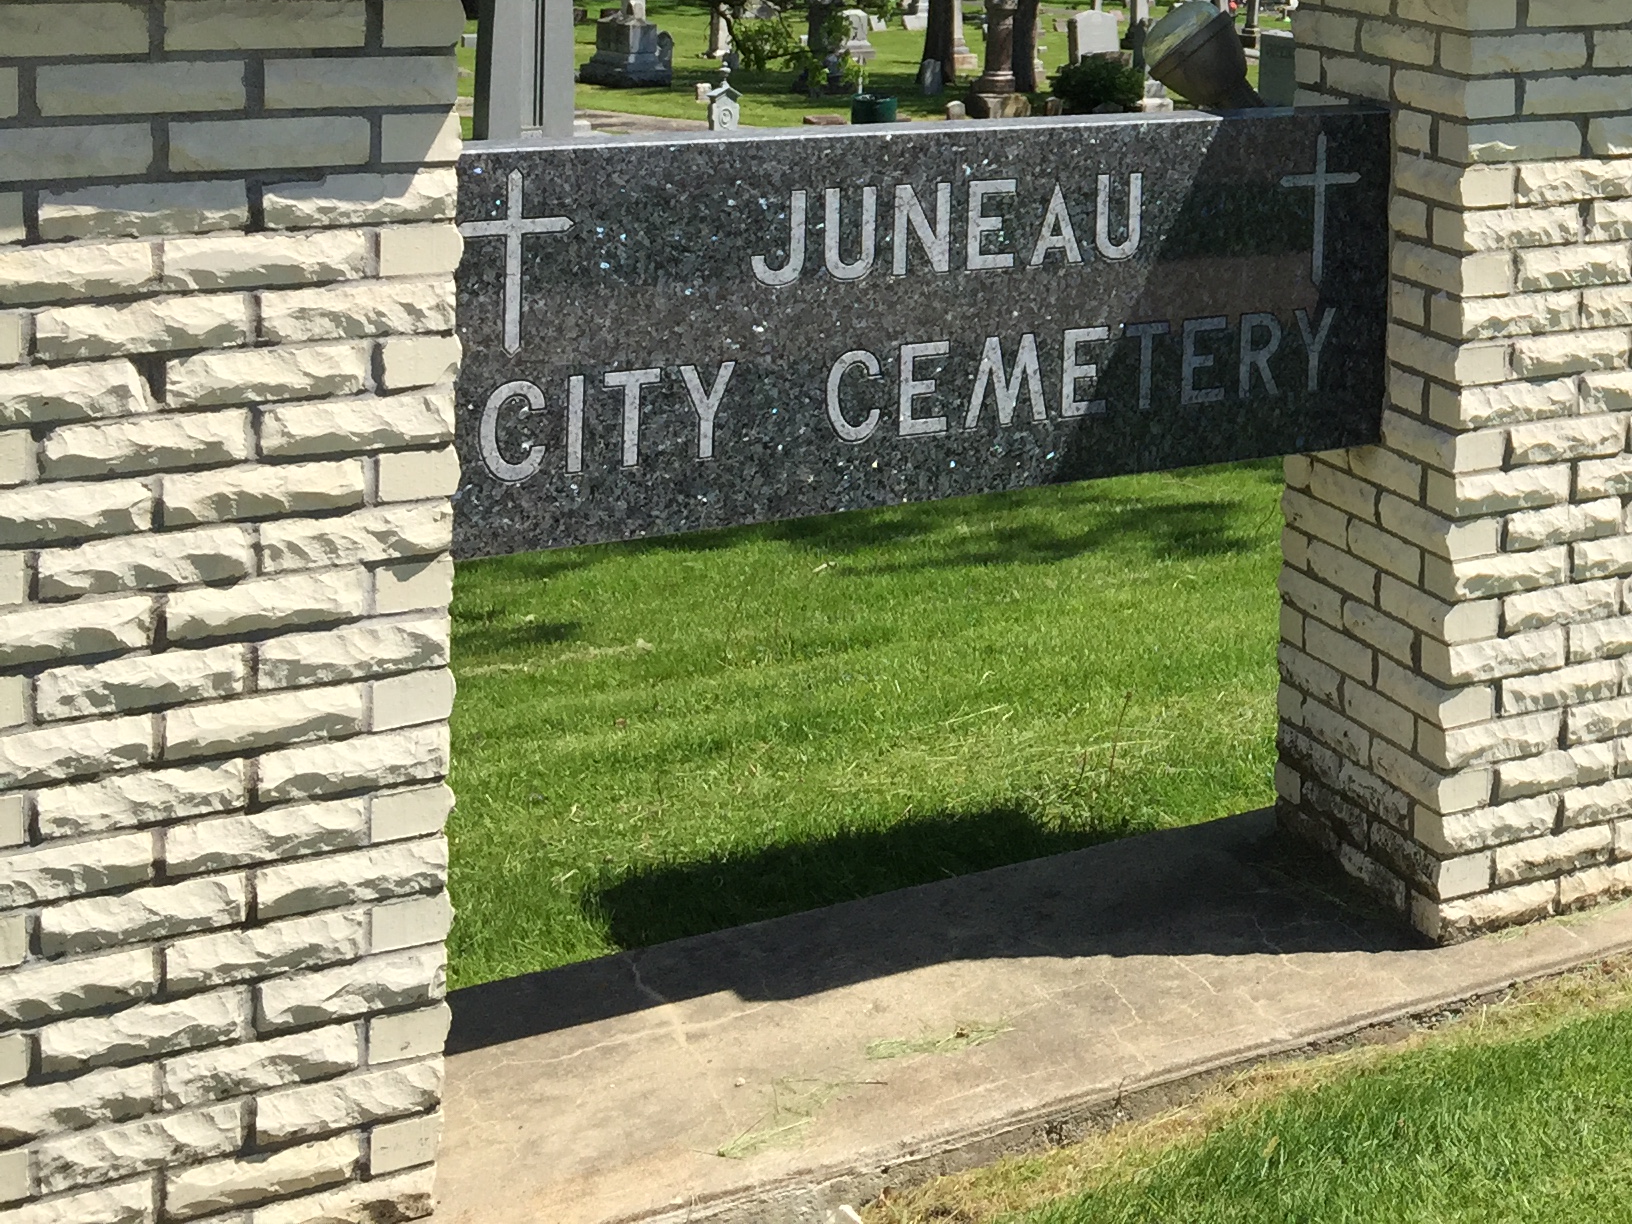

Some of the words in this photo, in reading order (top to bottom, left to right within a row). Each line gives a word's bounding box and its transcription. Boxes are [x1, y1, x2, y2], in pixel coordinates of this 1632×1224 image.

[752, 172, 1143, 286] JUNEAU
[478, 362, 736, 483] CITY
[825, 307, 1335, 444] CEMETERY
